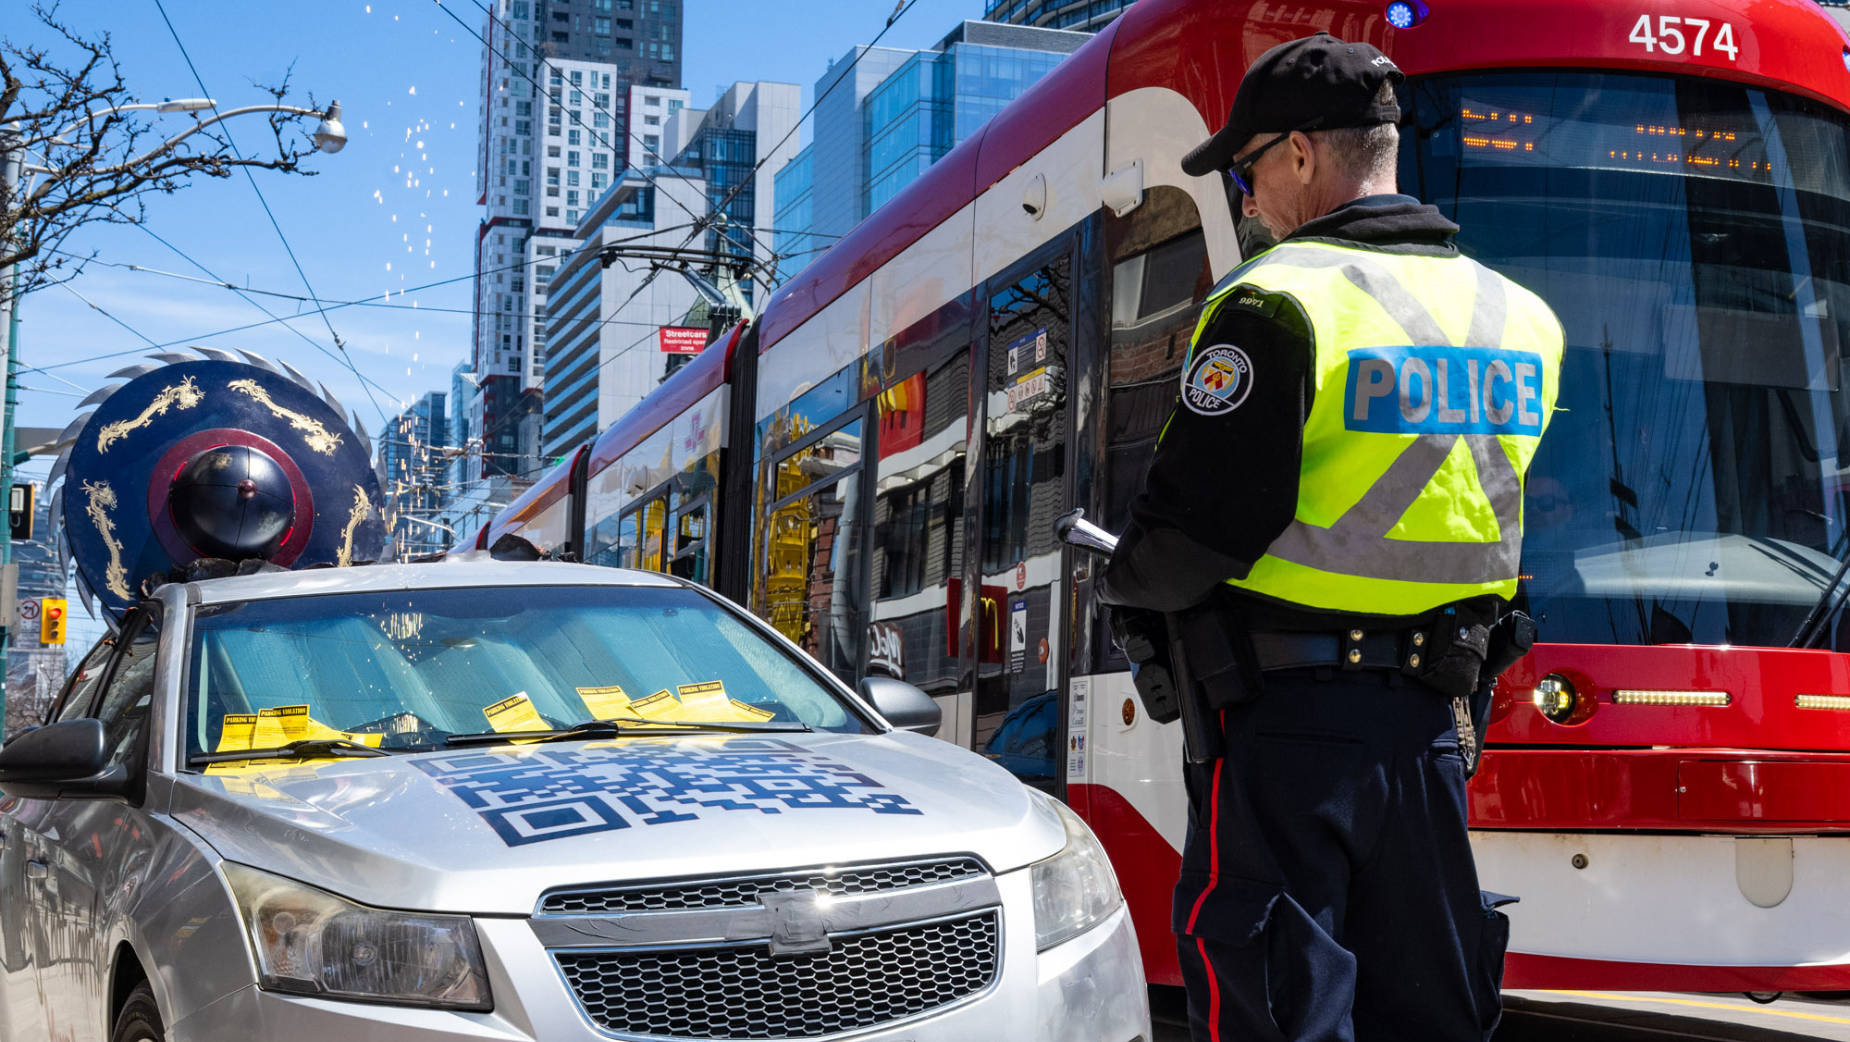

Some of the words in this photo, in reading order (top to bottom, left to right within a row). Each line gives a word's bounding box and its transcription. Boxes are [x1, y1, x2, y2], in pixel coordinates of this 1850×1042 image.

[1628, 14, 1739, 61] 4574
[1238, 297, 1265, 308] 9971
[666, 330, 707, 338] Streetcars
[1207, 349, 1248, 374] TORONTO
[1188, 388, 1221, 409] POLICE
[1353, 357, 1539, 426] POLICE
[226, 716, 248, 724] PARKING
[260, 709, 282, 717] PARKING
[282, 707, 307, 716] VIOLATION
